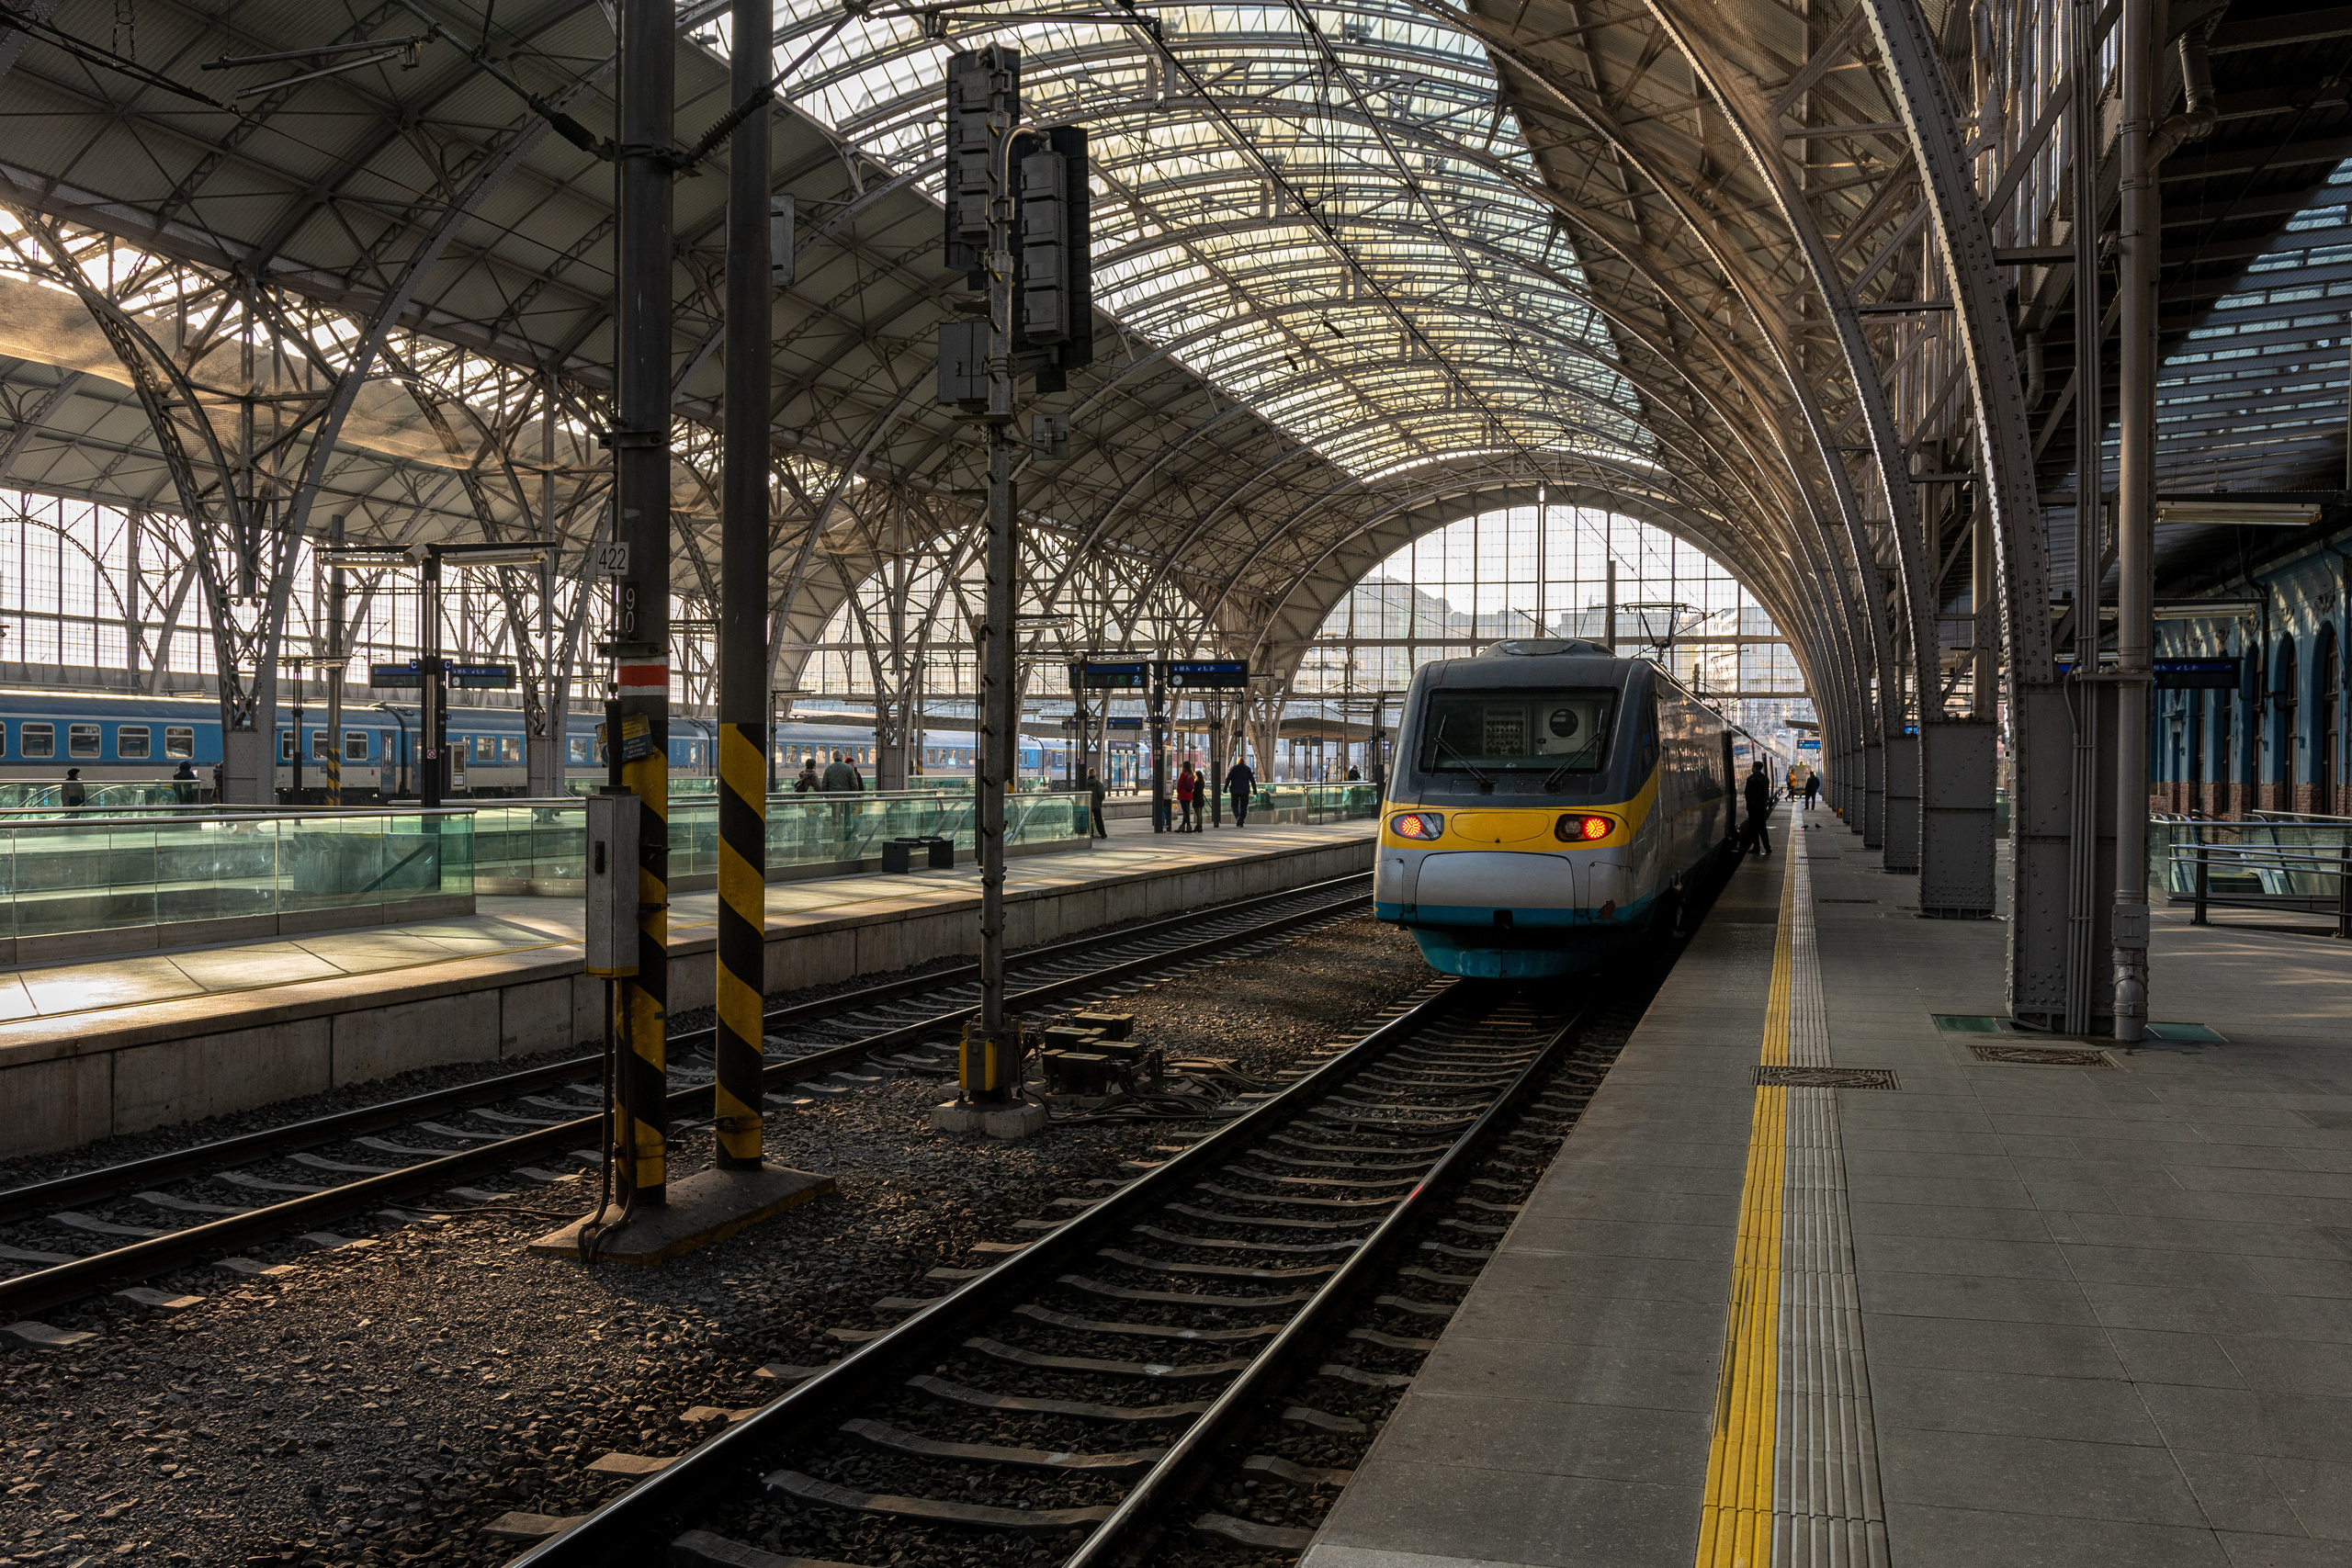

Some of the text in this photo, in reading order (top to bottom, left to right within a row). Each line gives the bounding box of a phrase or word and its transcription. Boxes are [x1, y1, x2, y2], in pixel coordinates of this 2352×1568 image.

[599, 548, 626, 570] 422
[411, 660, 417, 669] C
[444, 660, 451, 669] C
